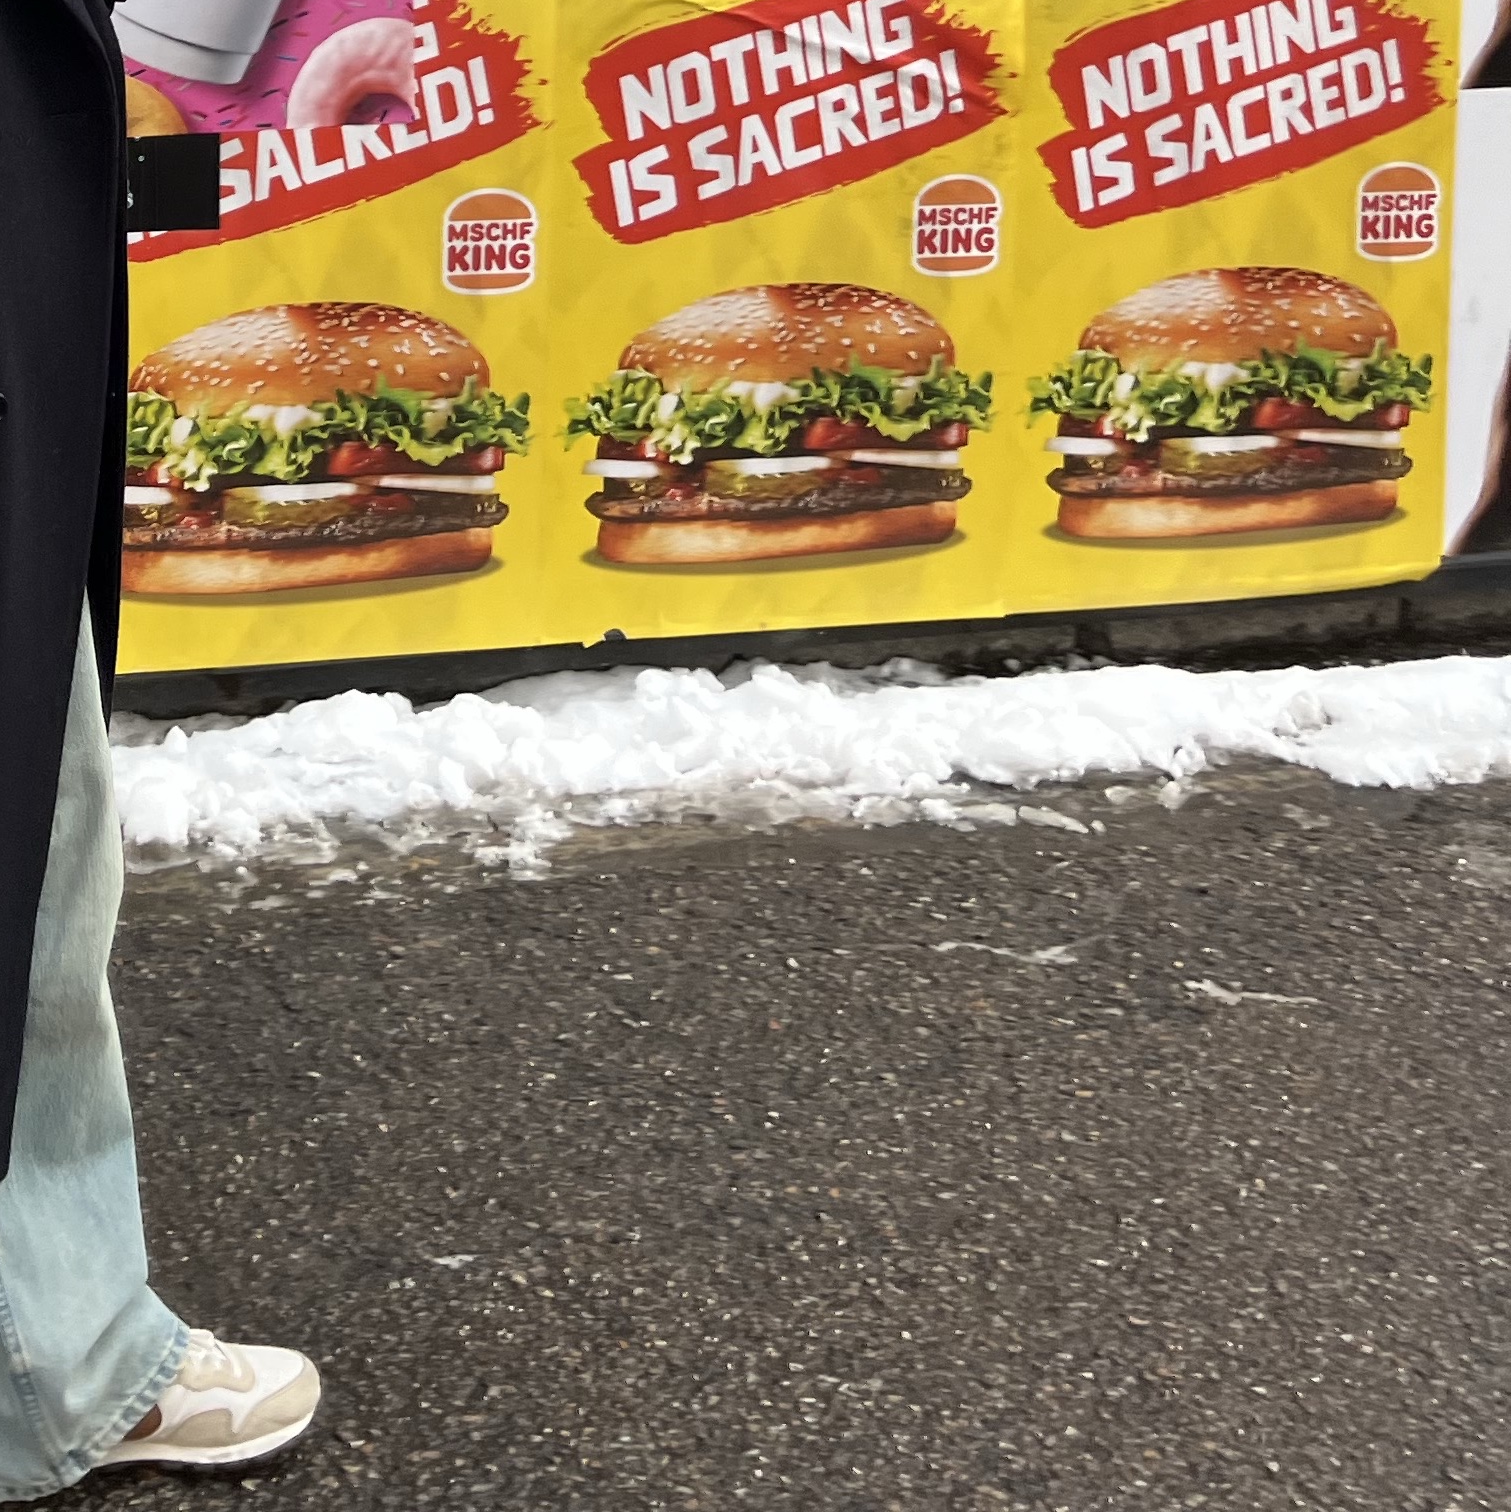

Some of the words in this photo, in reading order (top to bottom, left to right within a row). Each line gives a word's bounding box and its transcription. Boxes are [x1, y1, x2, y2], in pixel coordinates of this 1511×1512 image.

[607, 143, 678, 228] IS
[688, 48, 966, 203] SACRED!
[1071, 139, 1135, 213] IS
[1150, 38, 1406, 184] SACRED!
[917, 205, 999, 227] MSCHF
[1360, 192, 1438, 213] MSCHF
[447, 221, 533, 242] MSCHF
[1360, 213, 1438, 241] KING
[917, 228, 999, 256] KING
[447, 244, 533, 272] KING
